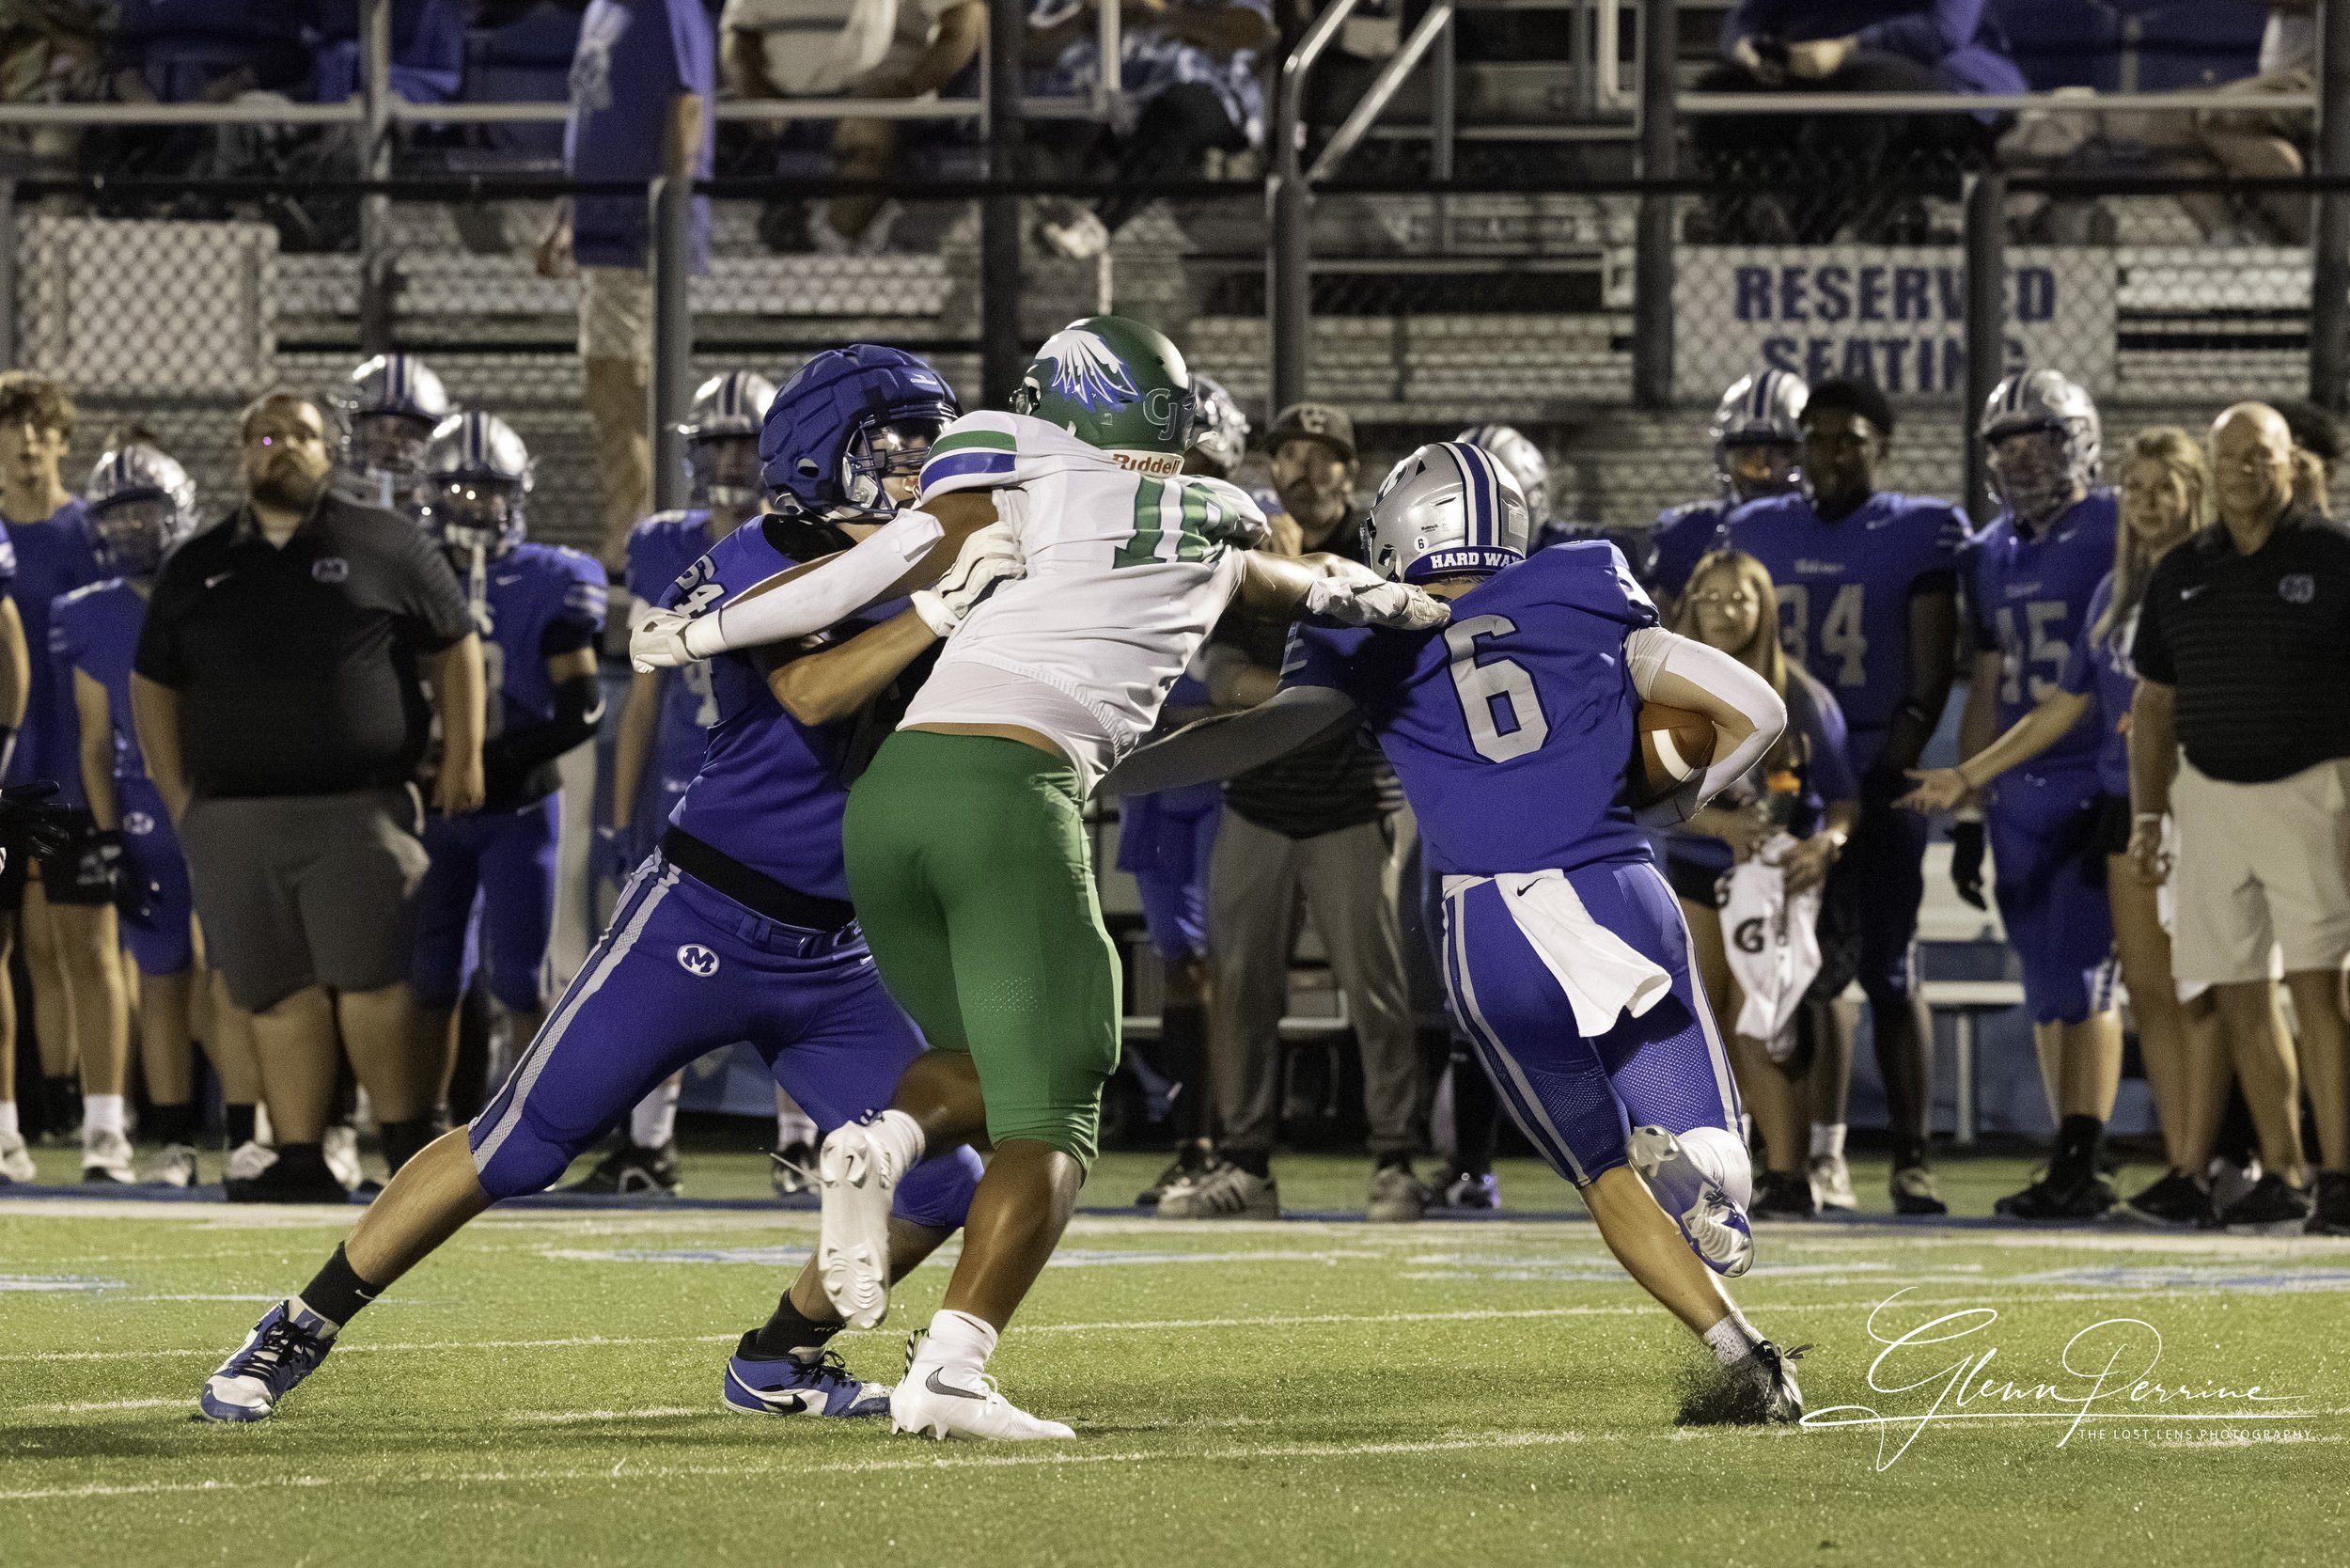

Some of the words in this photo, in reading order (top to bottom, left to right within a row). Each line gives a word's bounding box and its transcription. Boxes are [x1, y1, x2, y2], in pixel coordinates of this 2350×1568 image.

[1735, 265, 2057, 321] RESERVD
[1418, 538, 1426, 550] 6
[1430, 552, 1480, 569] HARD
[1443, 613, 1552, 765] 6
[1734, 917, 1765, 953] G
[681, 946, 717, 975] M
